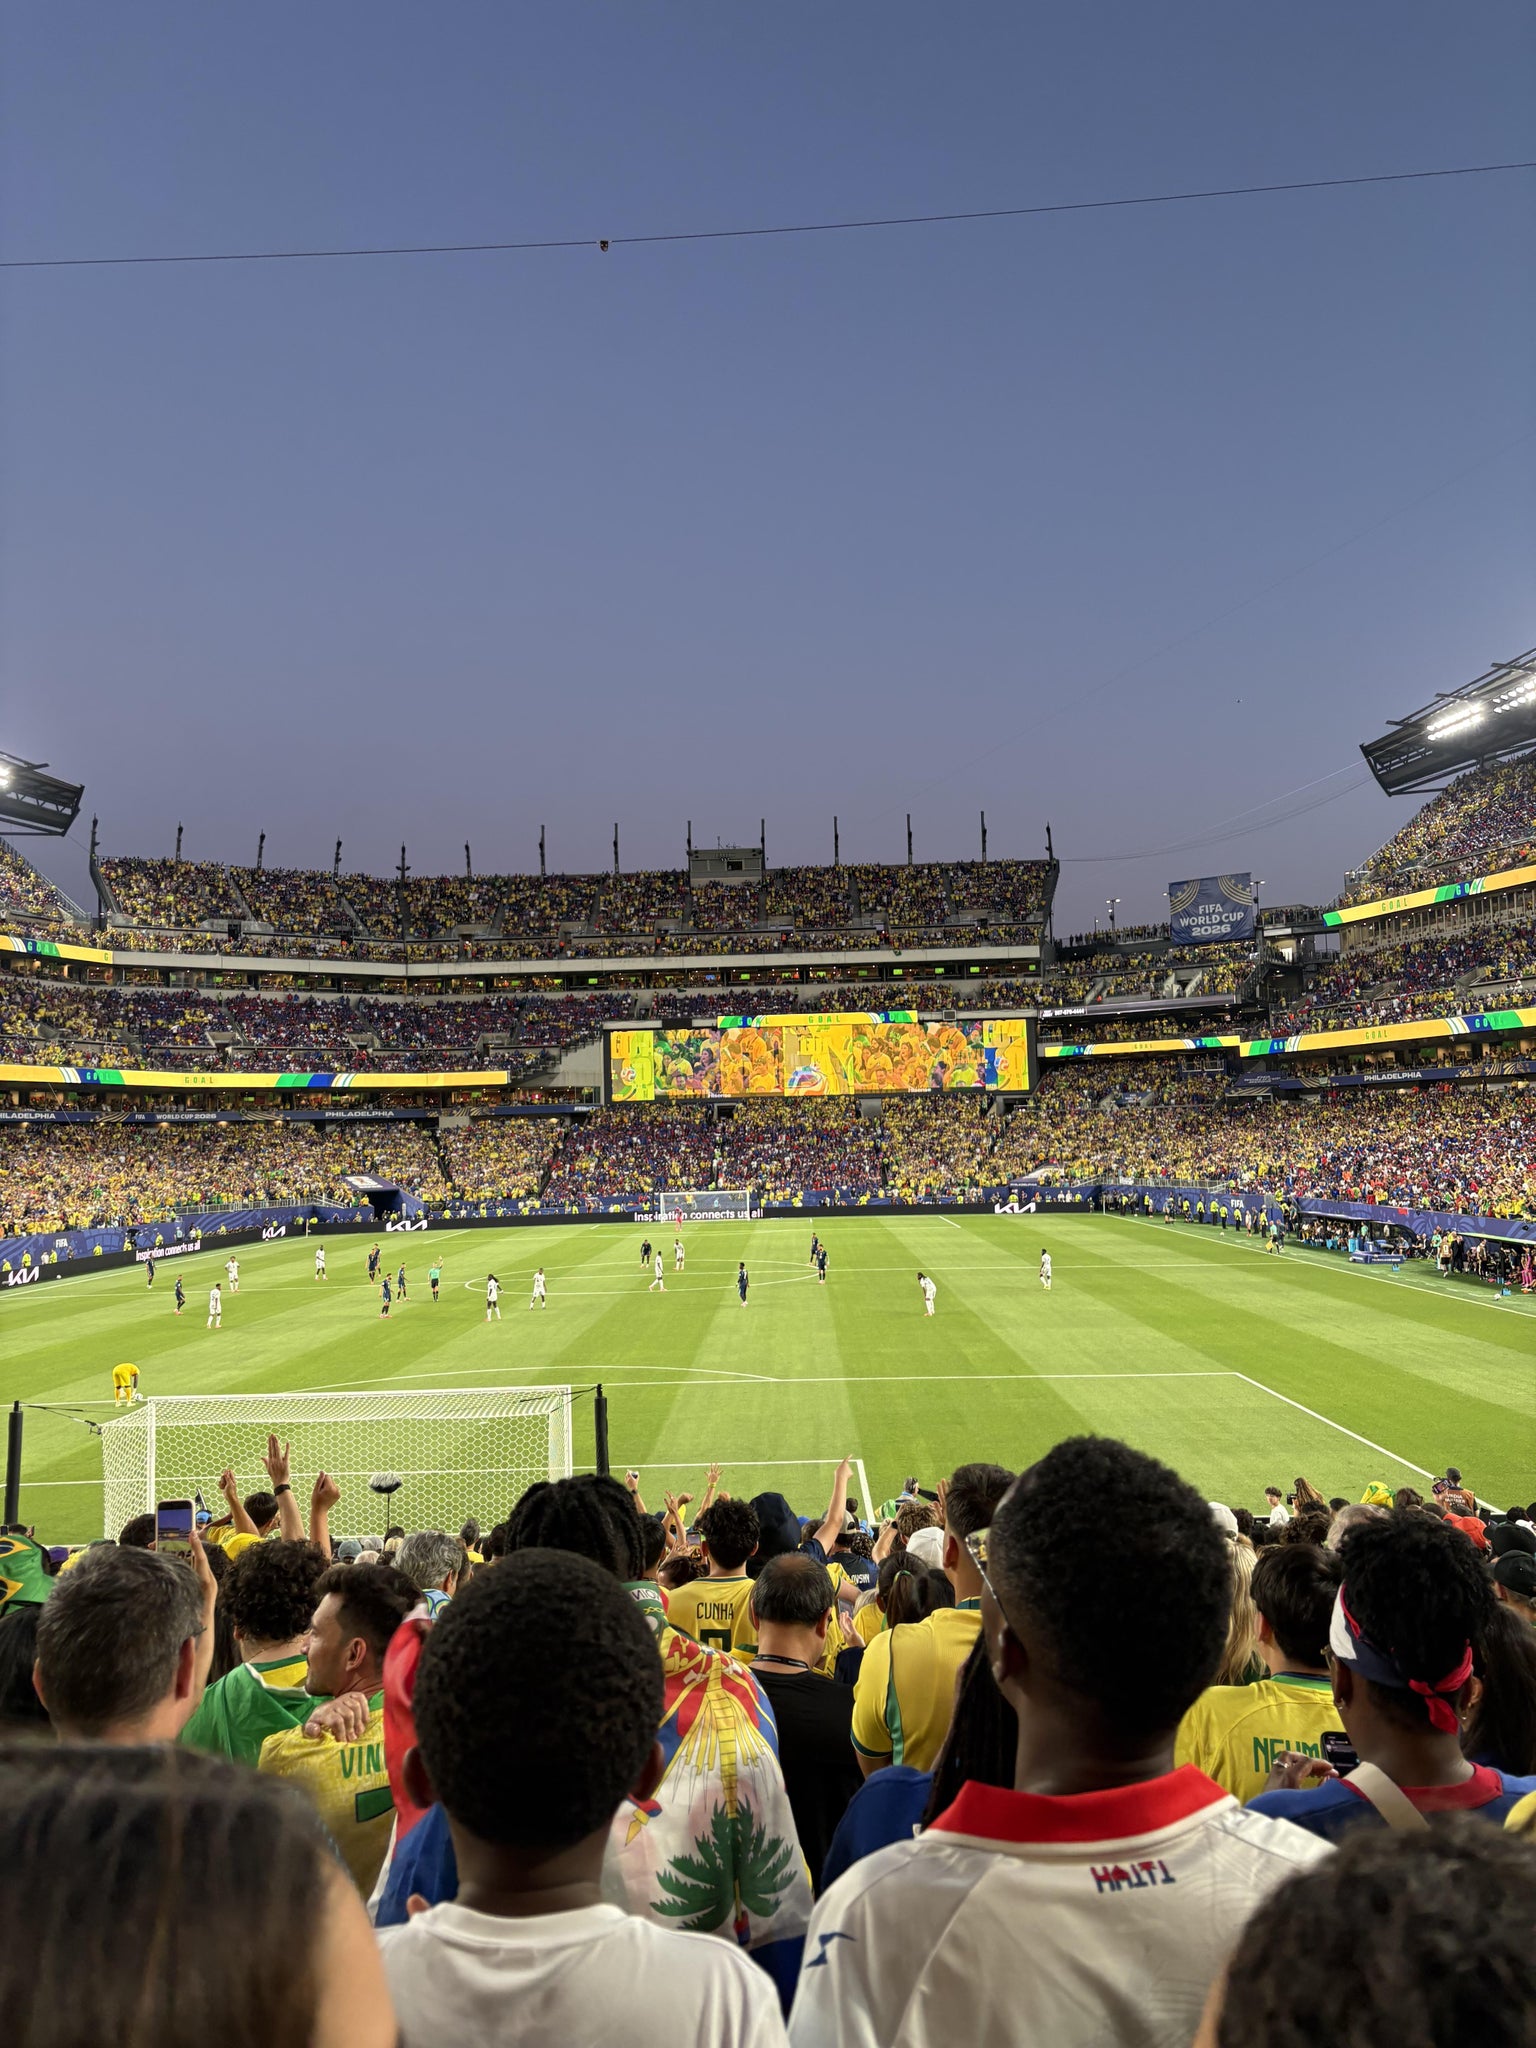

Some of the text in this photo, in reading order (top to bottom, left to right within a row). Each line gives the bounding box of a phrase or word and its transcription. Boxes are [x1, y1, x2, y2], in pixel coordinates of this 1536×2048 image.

[1199, 903, 1223, 914] FIFA
[1382, 898, 1407, 912] GOAL
[1180, 912, 1245, 927] WORLD CUP
[1192, 924, 1231, 936] 2026
[27, 941, 57, 952] GOAL
[808, 1015, 840, 1023] GOAL
[1365, 1030, 1387, 1040] GOAL
[184, 1076, 214, 1084] GOAL
[1363, 1071, 1422, 1081] PHILADELPHIA
[0, 1112, 56, 1120] HILADELPHIA
[1230, 1199, 1244, 1209] FIFA
[690, 1209, 735, 1220] connects
[751, 1208, 764, 1218] all
[55, 1238, 68, 1248] FIFA
[165, 1243, 187, 1256] connects
[696, 1602, 735, 1621] CUNHA
[340, 1742, 387, 1779] VIN
[1090, 1859, 1176, 1894] HAITI
